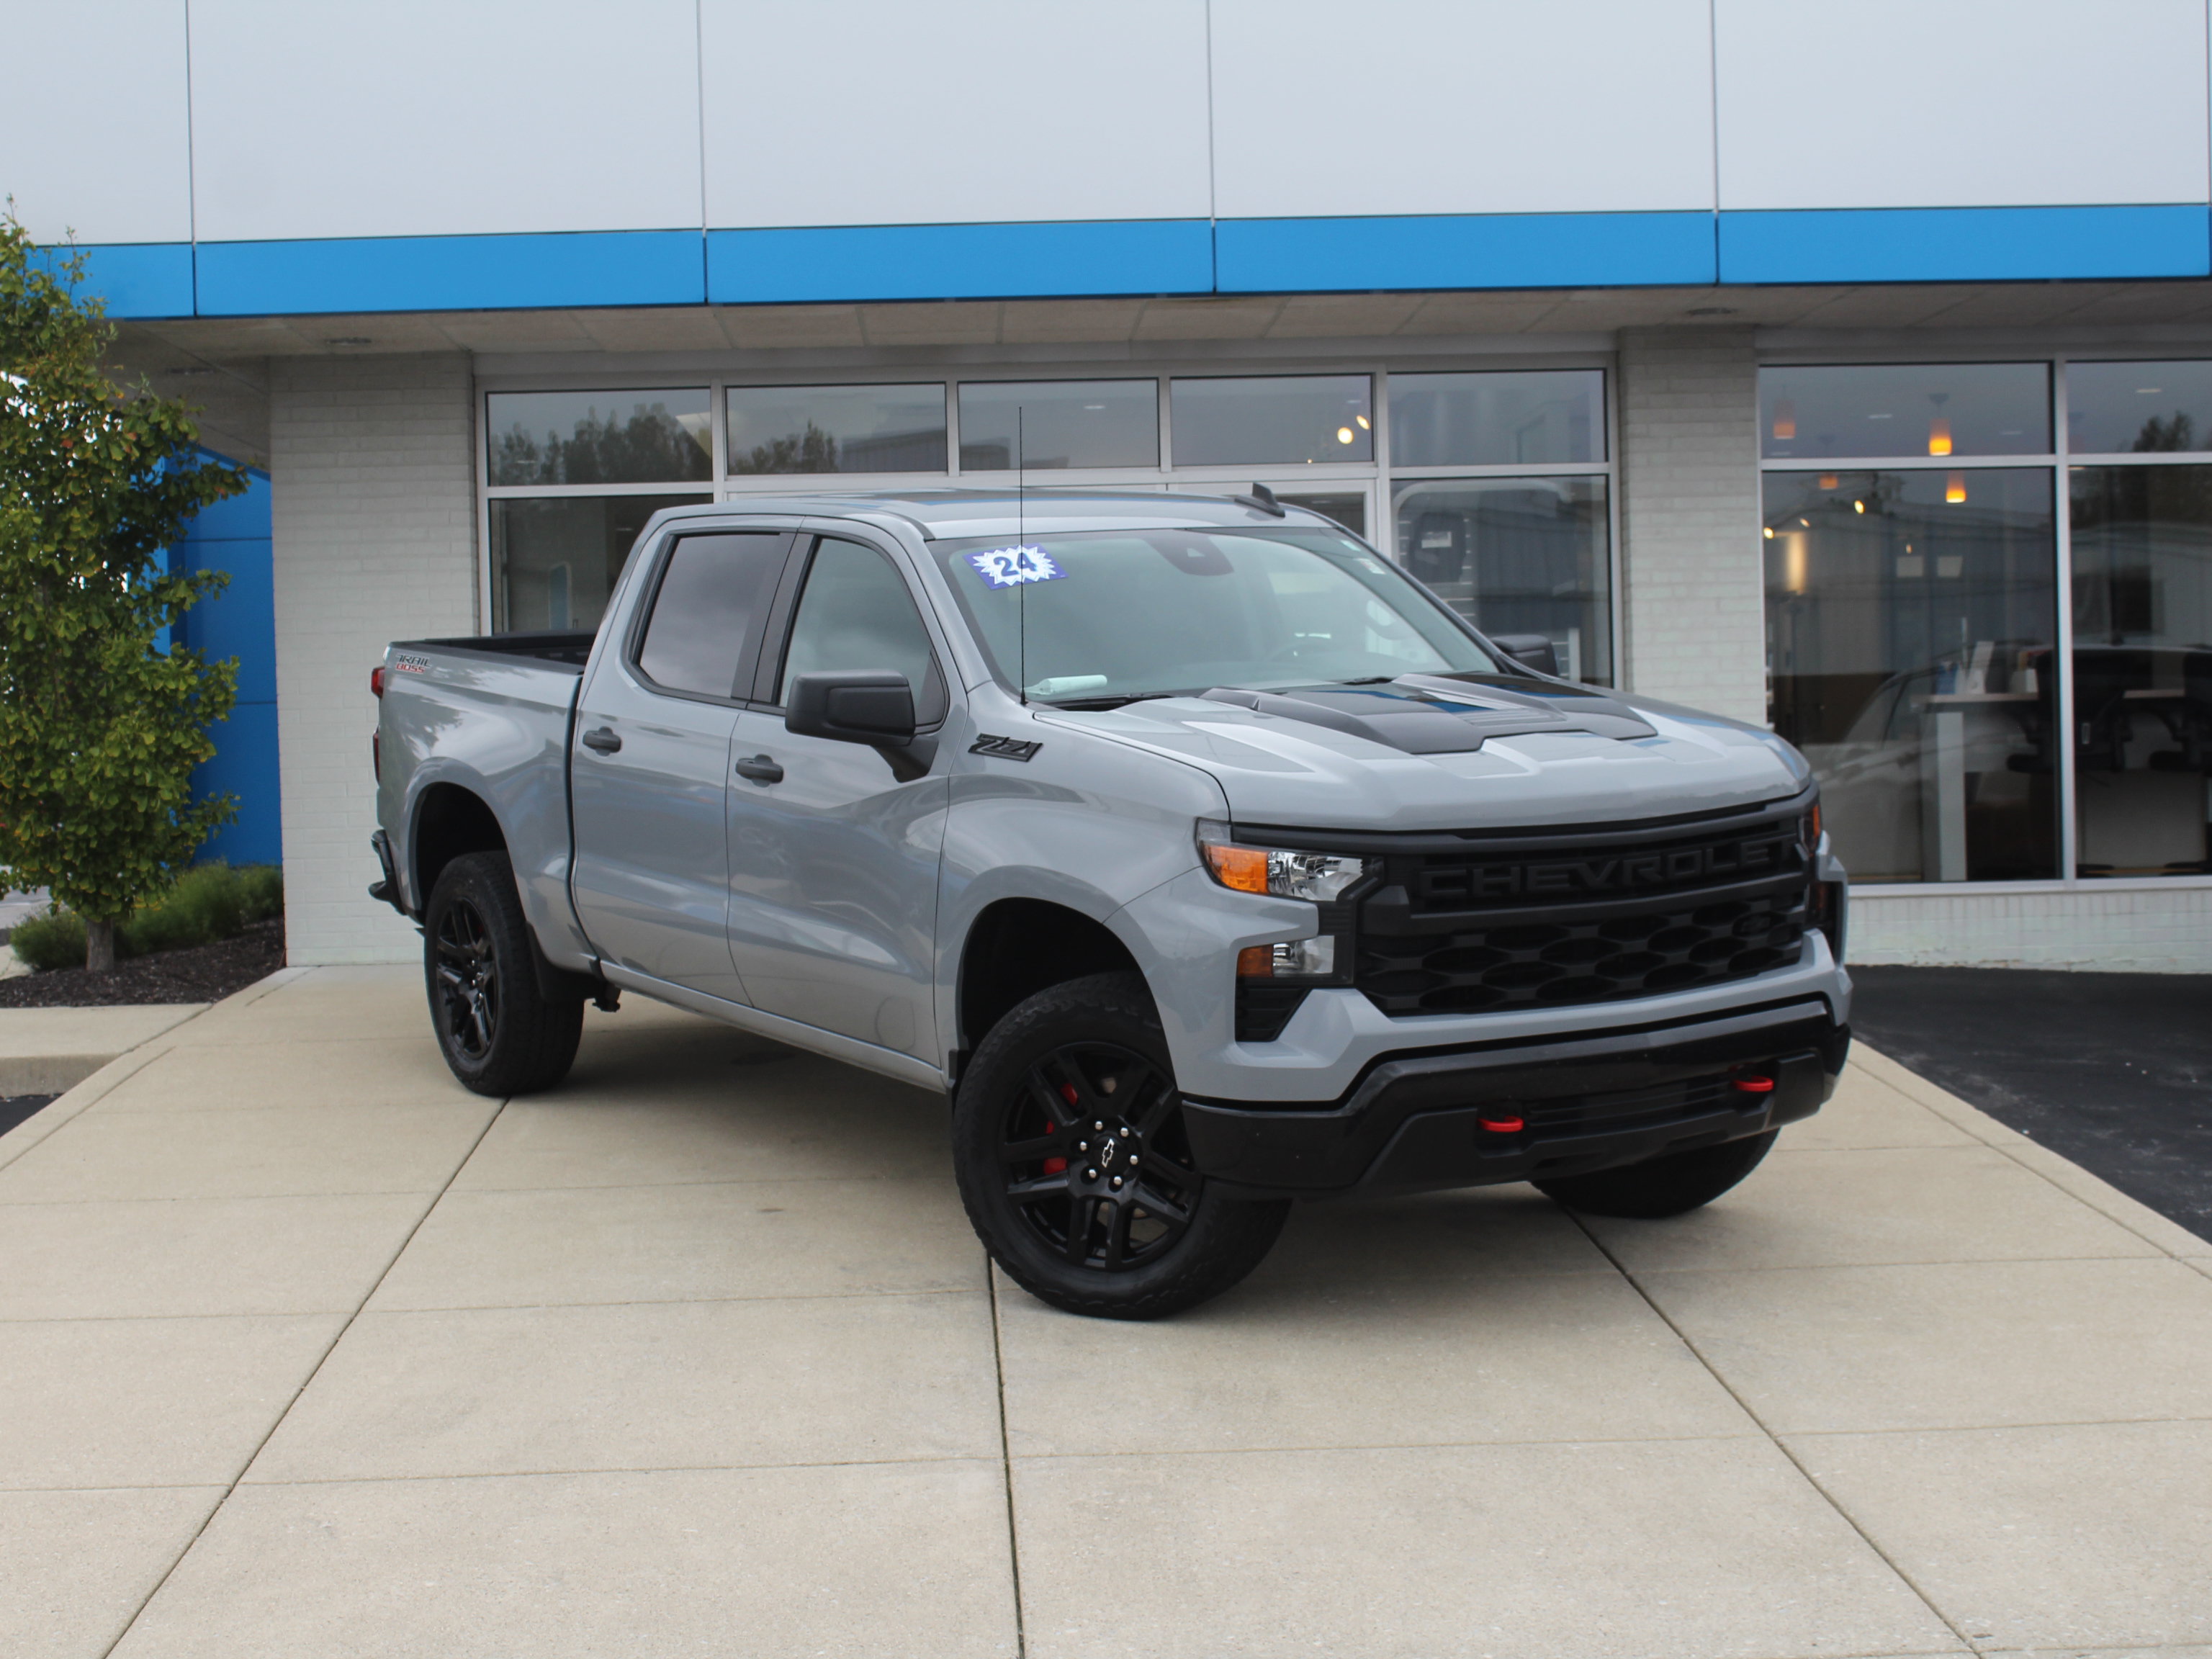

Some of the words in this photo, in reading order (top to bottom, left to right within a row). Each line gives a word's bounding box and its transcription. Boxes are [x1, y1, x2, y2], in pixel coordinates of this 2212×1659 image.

[994, 552, 1038, 576] 24
[396, 663, 425, 673] BOSS
[397, 655, 432, 667] TRAIL
[1419, 833, 1796, 896] CHEVROLET
